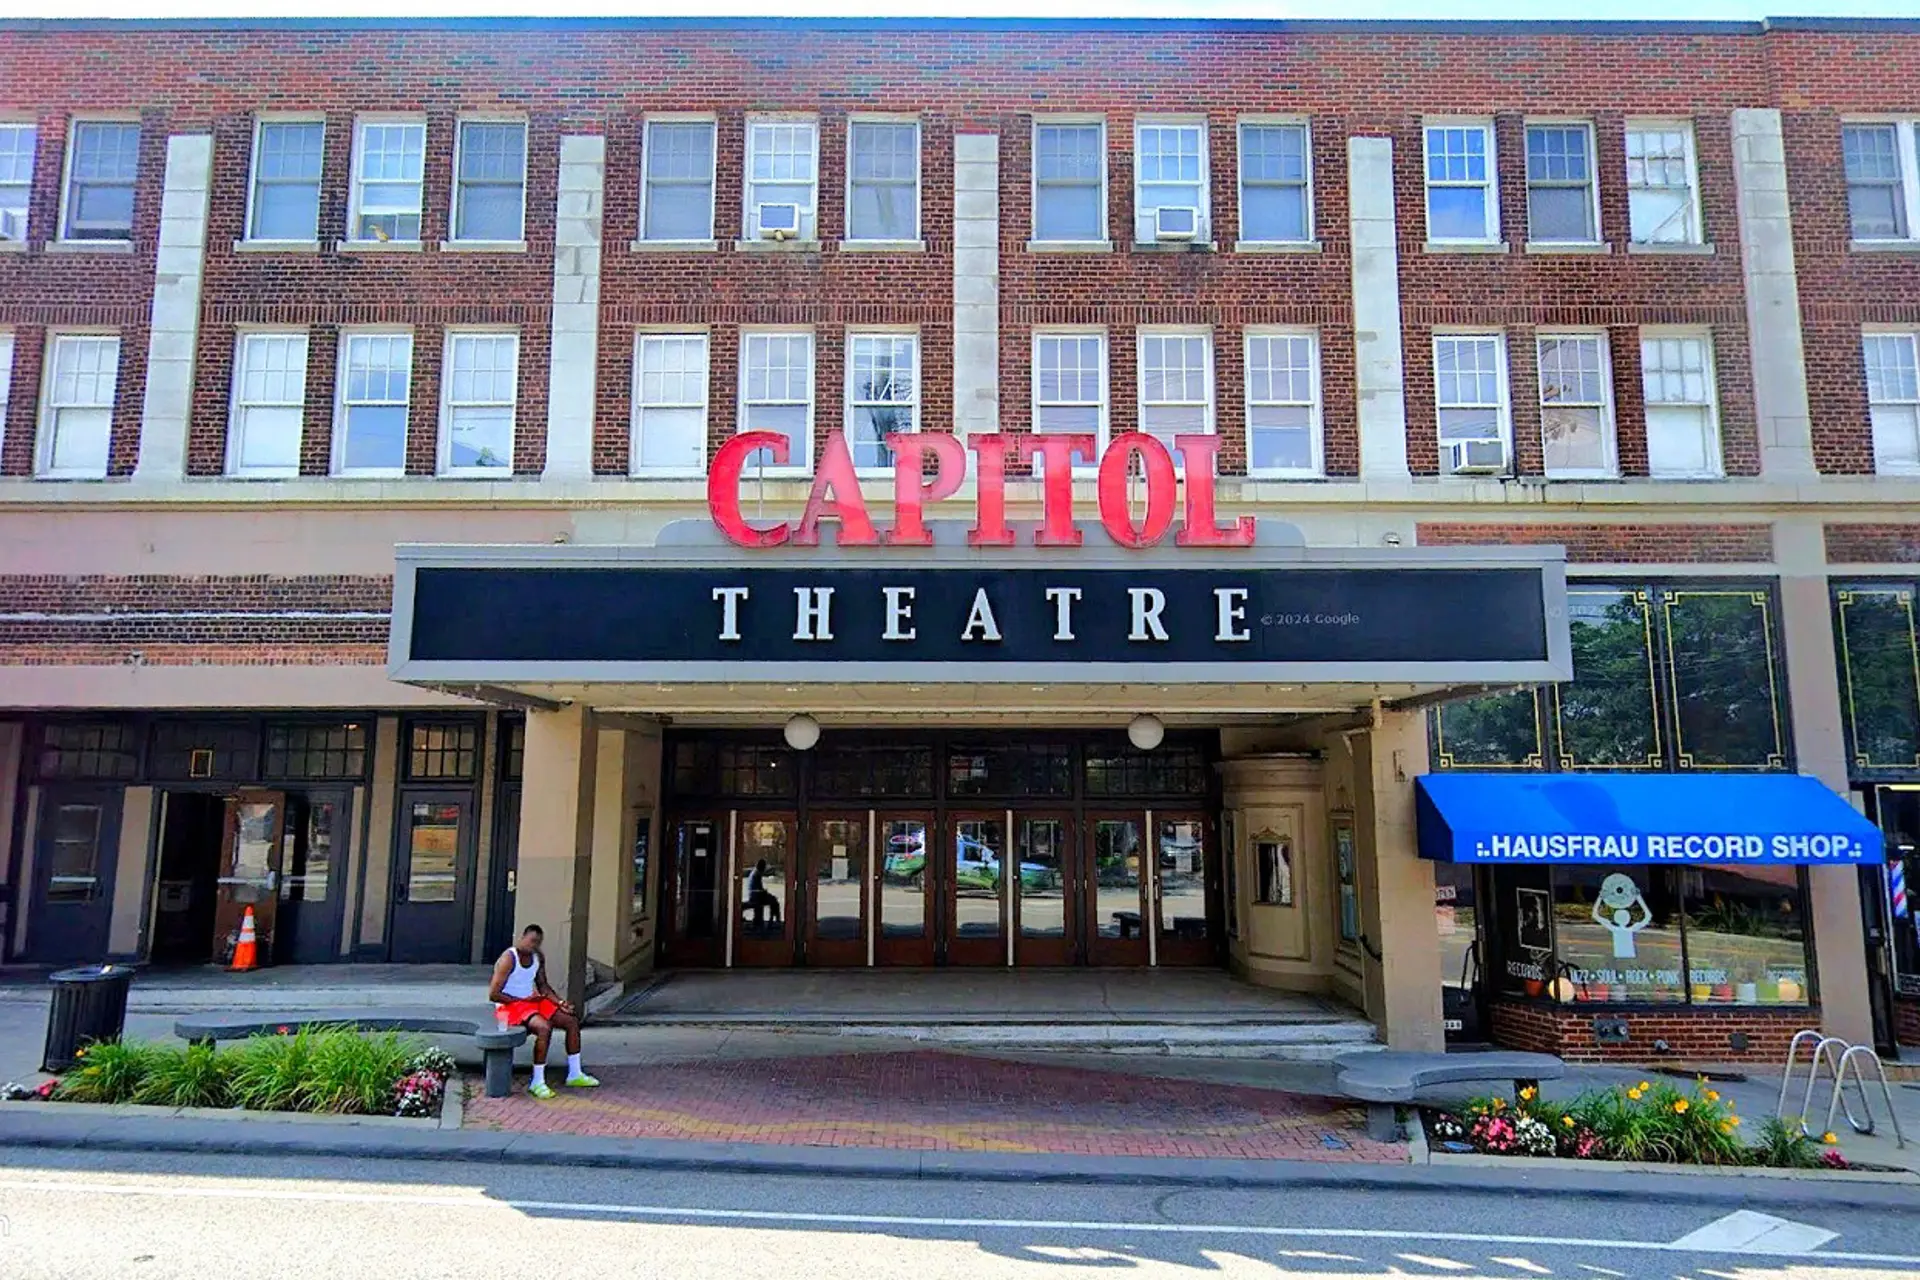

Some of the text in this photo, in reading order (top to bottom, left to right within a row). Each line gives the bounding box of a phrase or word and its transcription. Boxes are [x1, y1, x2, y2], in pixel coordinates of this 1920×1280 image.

[707, 430, 1256, 549] CAPITOL
[712, 587, 1250, 641] THEATRE
[1647, 836, 1764, 858] RECORD
[1597, 969, 1619, 985] SOUL
[1626, 969, 1650, 985] ROCK
[1655, 969, 1681, 985] PUNK
[1690, 969, 1728, 985] RECORDS
